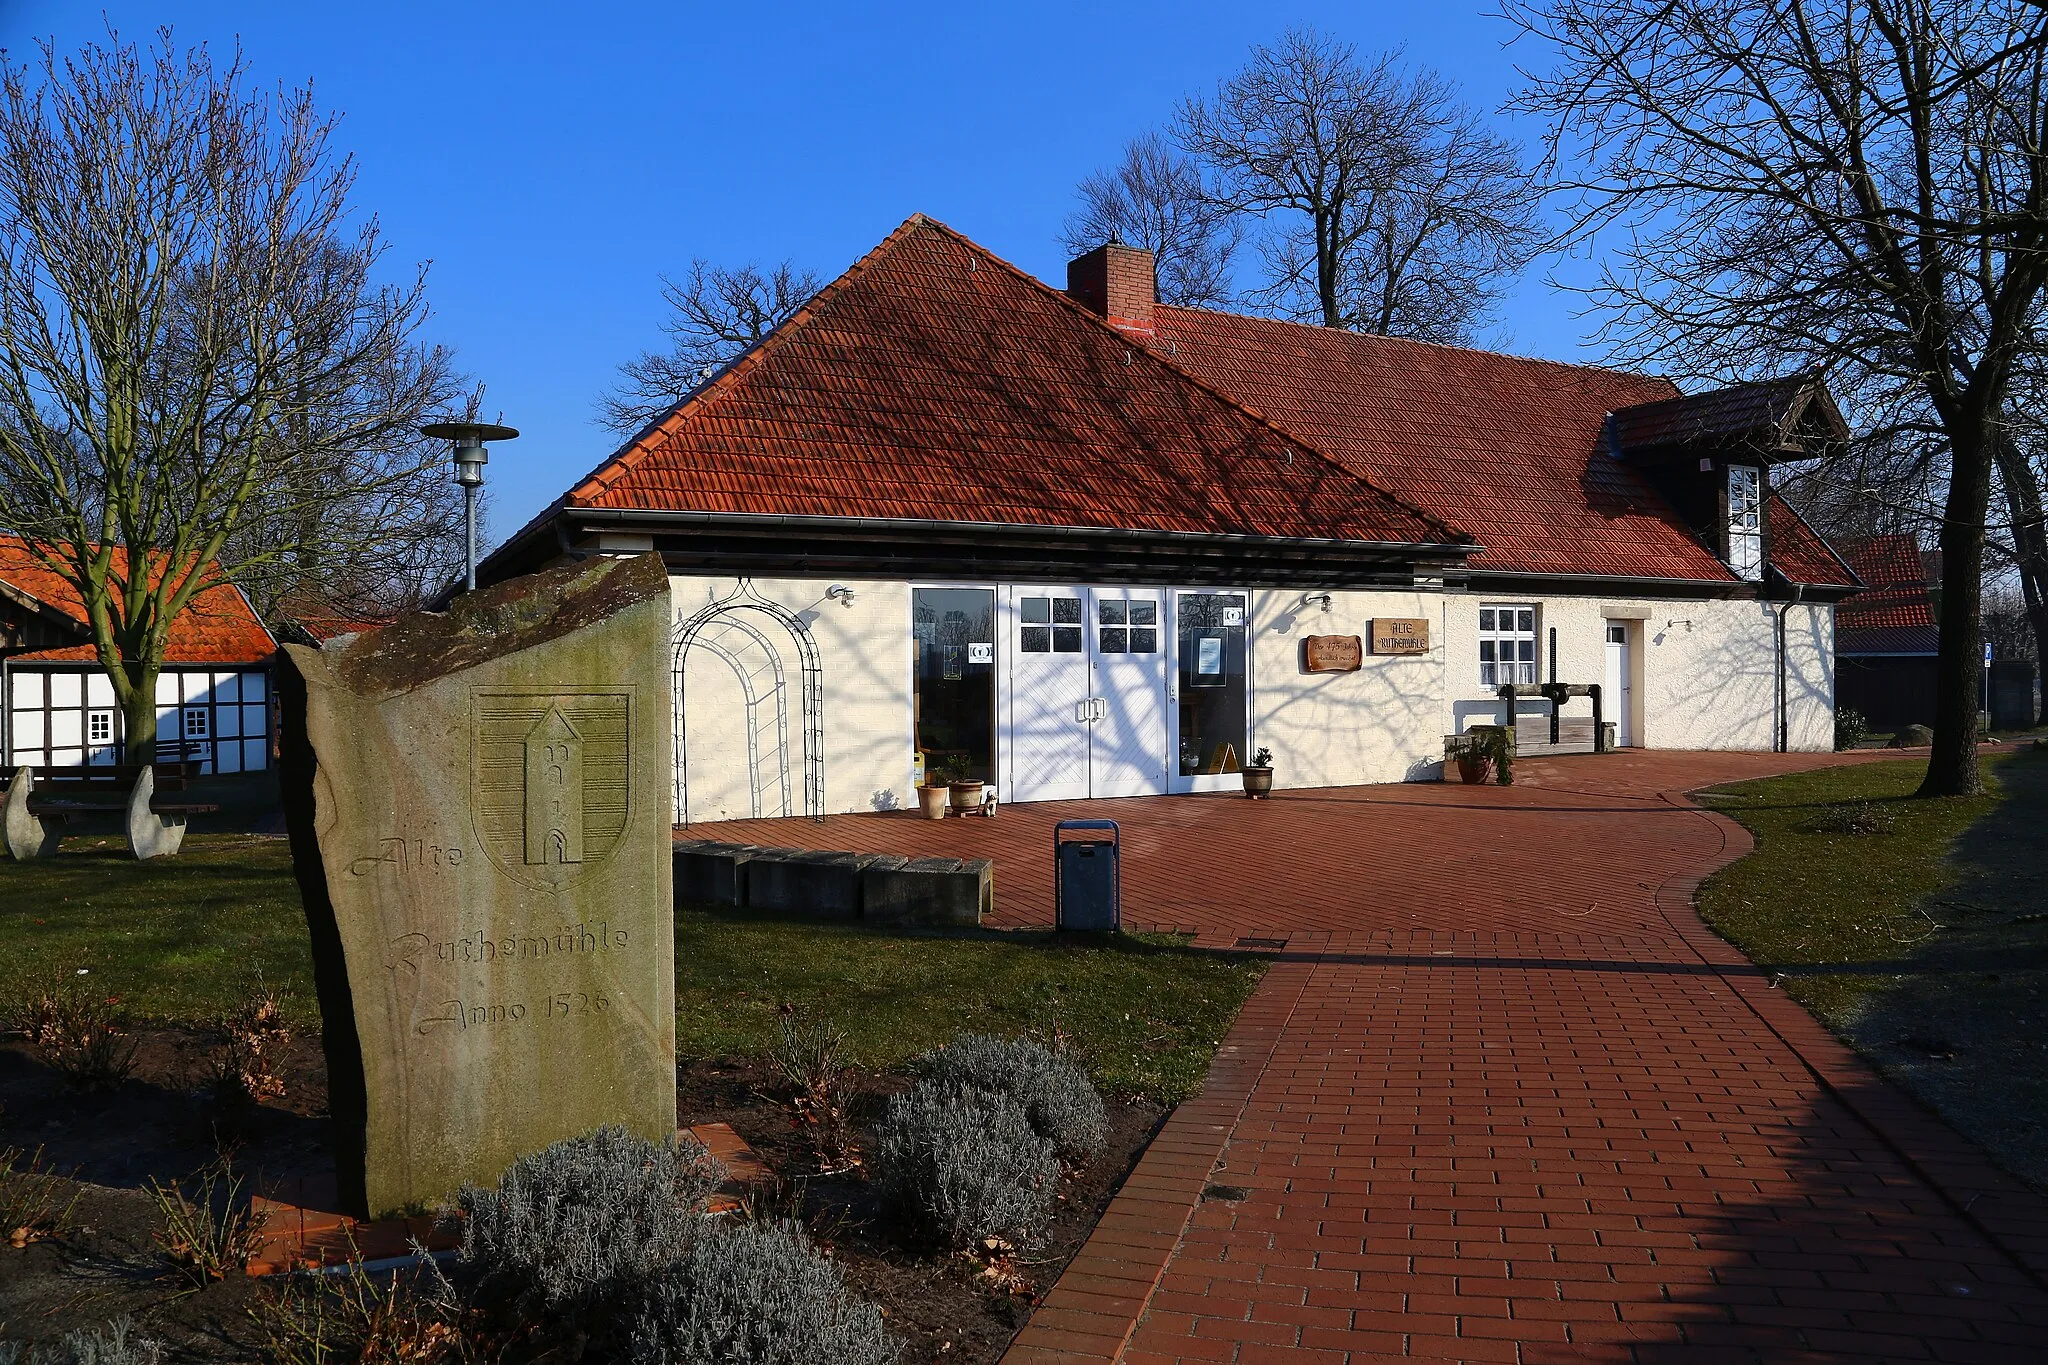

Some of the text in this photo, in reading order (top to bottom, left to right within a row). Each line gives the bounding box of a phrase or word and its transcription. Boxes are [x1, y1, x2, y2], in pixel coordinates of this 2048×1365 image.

[1392, 622, 1413, 634] ALTE
[1985, 645, 1991, 657] P
[345, 837, 462, 876] Alte
[418, 991, 611, 1036] Anno 1526
